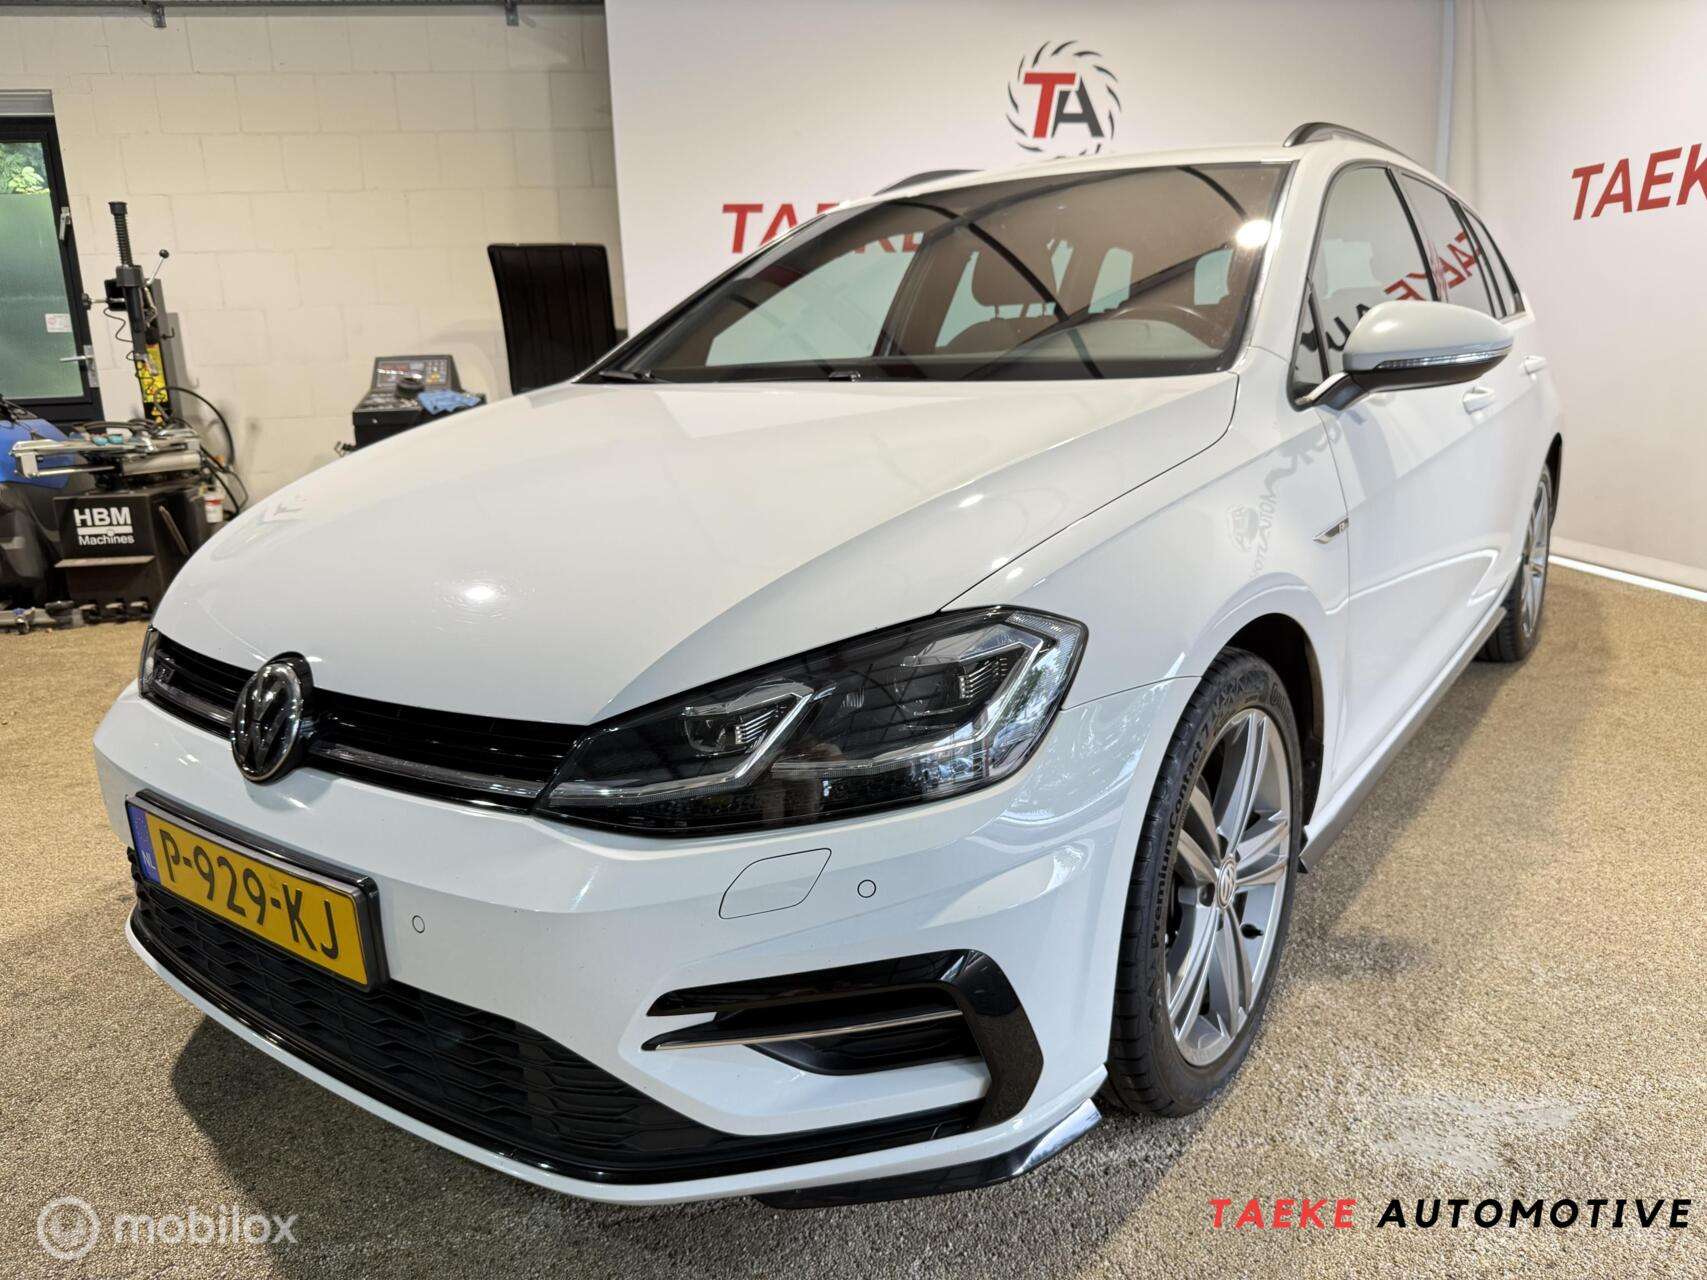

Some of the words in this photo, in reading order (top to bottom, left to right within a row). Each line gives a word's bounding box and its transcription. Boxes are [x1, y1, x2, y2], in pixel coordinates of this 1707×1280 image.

[1023, 72, 1104, 138] TA
[73, 506, 132, 527] HBM
[78, 534, 135, 546] Machines
[159, 828, 340, 960] P-929-KJ
